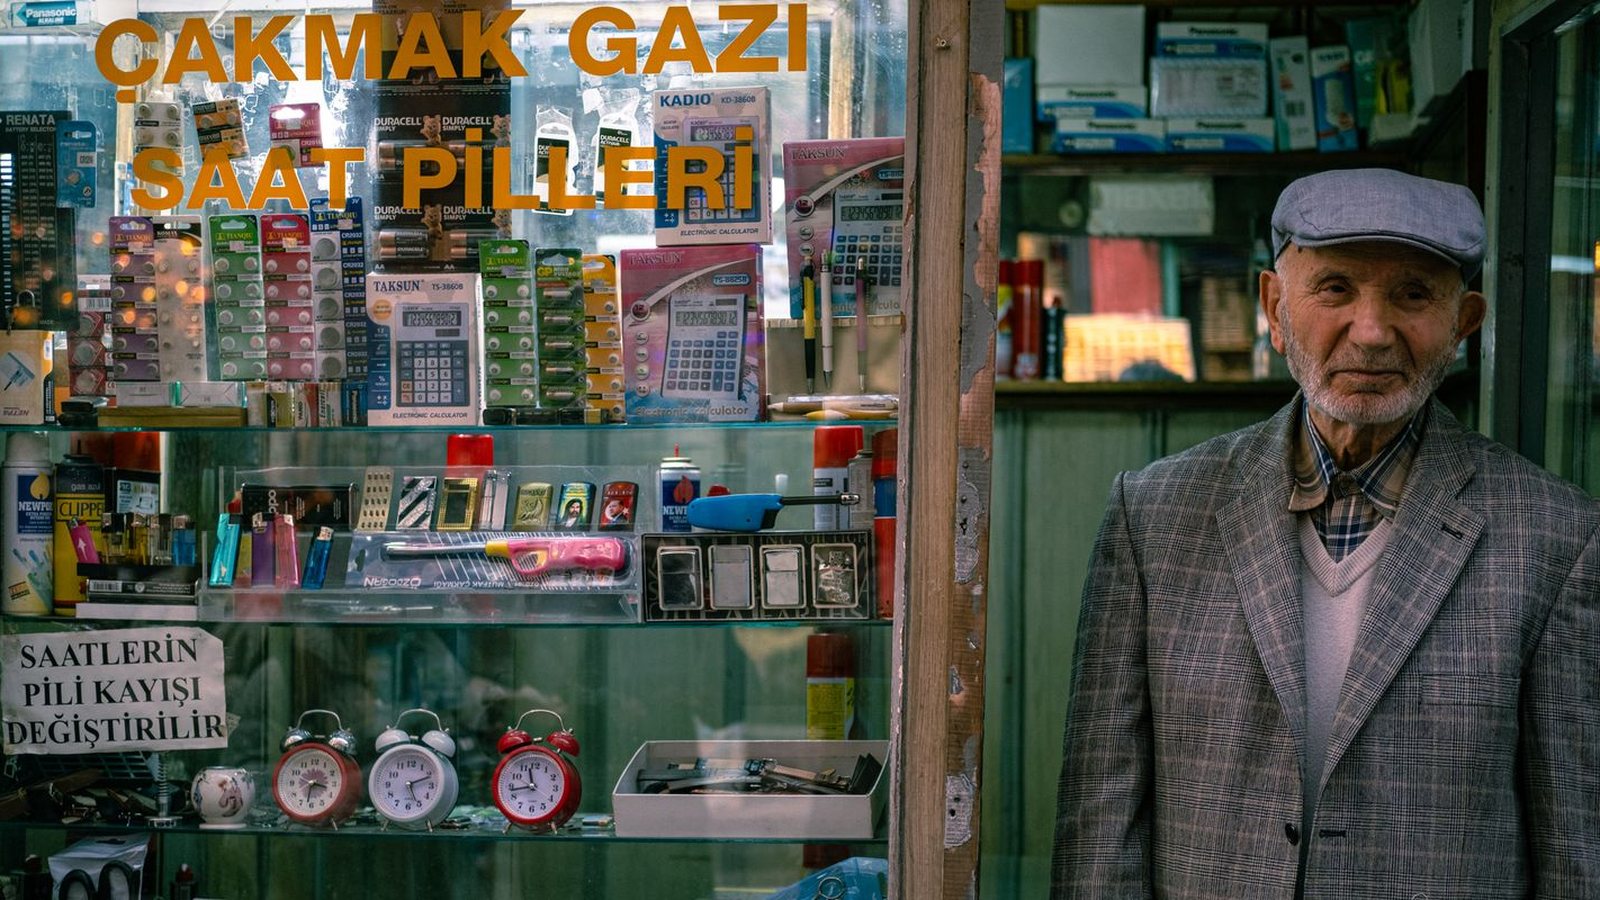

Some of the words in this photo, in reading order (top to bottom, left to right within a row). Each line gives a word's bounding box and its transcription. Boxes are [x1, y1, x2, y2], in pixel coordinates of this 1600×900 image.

[26, 6, 77, 17] Panasonic
[95, 9, 528, 103] ÇAKMAK
[568, 3, 807, 76] GAZI
[660, 93, 712, 107] KADIO
[6, 114, 55, 126] RENATA
[375, 116, 421, 126] DURACELL
[442, 116, 492, 126] DURACELL
[600, 134, 630, 144] DURACELL
[792, 147, 845, 160] TAKSUN
[131, 147, 364, 211] SAAT
[403, 126, 753, 210] PİLLERİ
[374, 206, 423, 215] DURACELL
[443, 206, 493, 215] DURACELL
[680, 228, 717, 236] ELECTRONIC
[719, 227, 759, 235] CALCULATOR
[630, 252, 682, 265] TAKSUN
[537, 266, 552, 277] GP
[373, 280, 421, 292] TAKSUN
[430, 411, 468, 419] CALCULATOR
[60, 502, 103, 517] CLIPPE
[21, 633, 198, 669] SAATLERİN
[22, 675, 84, 707] PİLİ
[93, 676, 202, 707] KAYIŞI
[4, 709, 225, 749] DEĞİŞTİRİLİR
